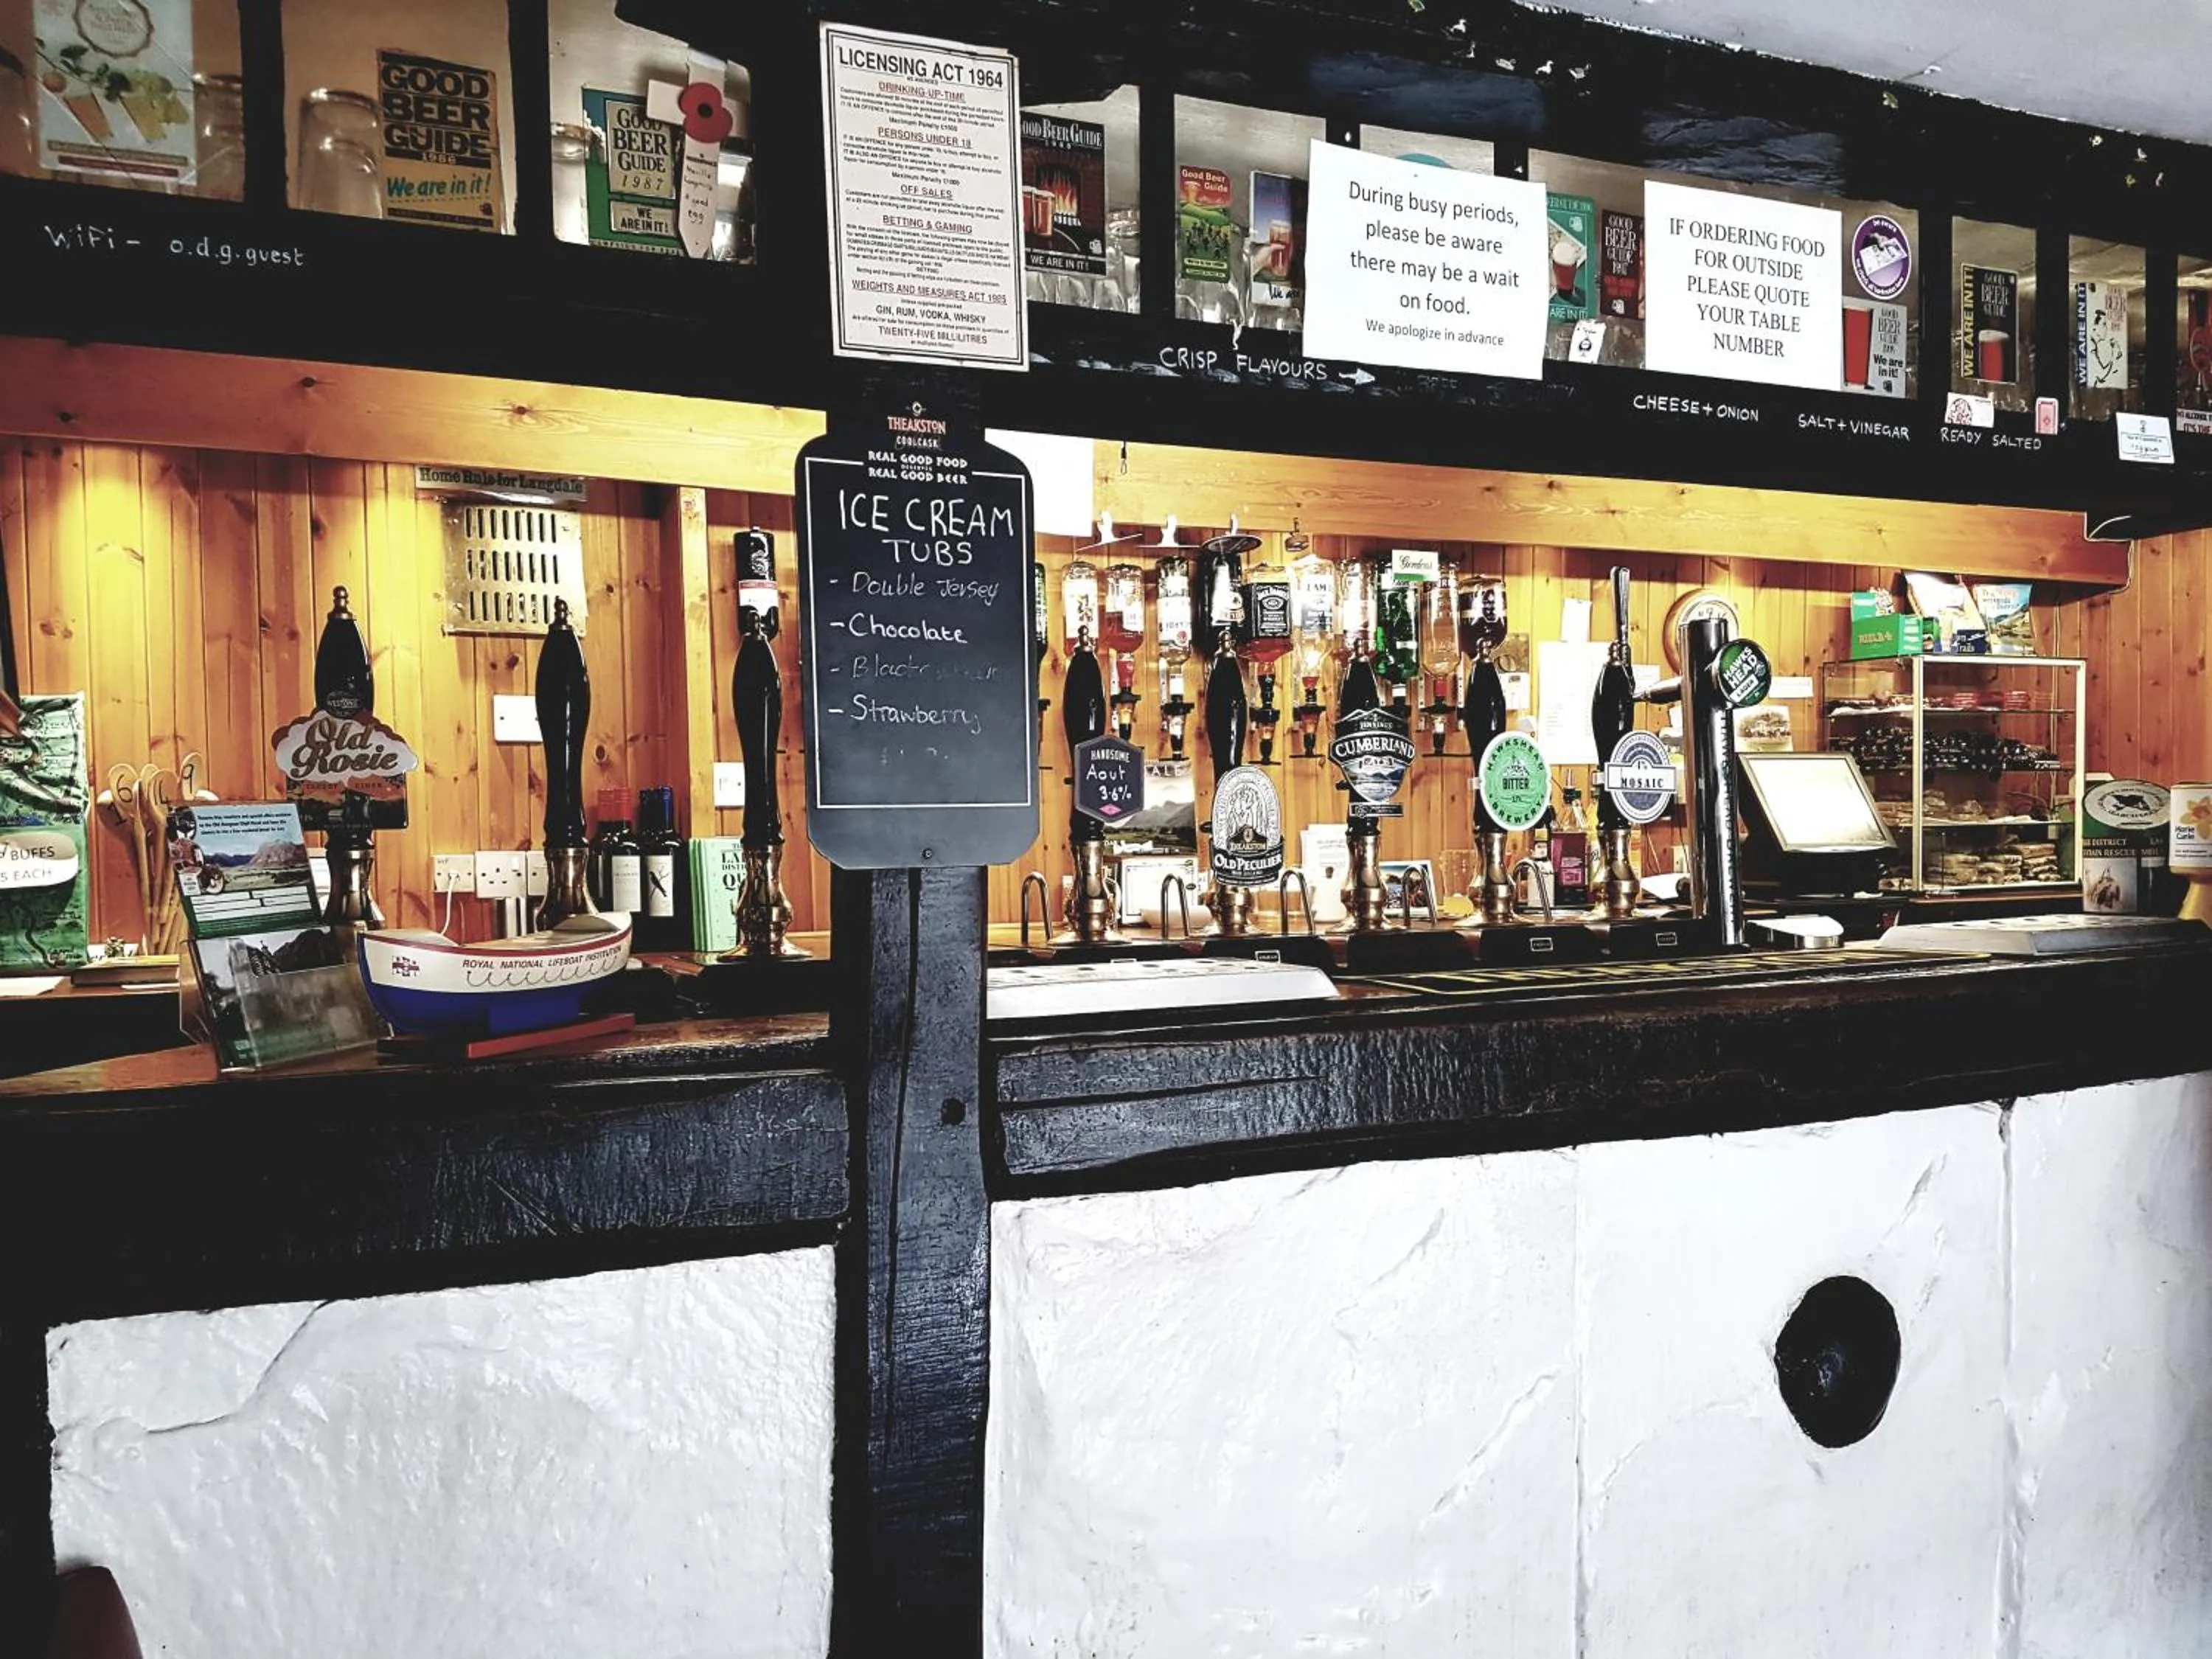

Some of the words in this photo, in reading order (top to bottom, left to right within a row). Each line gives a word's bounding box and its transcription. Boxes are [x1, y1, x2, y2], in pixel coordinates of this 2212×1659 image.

[838, 46, 927, 77] LICENSING
[932, 62, 963, 83] ACT
[968, 68, 1003, 88] 1964
[381, 63, 490, 99] GOOD
[383, 92, 490, 131] BEER
[383, 124, 491, 157] GUIDE
[613, 128, 669, 156] BEER
[878, 127, 922, 142] PERSONS
[926, 135, 959, 147] UNDER
[1022, 120, 1041, 137] OOD
[1043, 118, 1069, 143] BEER
[1070, 123, 1102, 147] GUIDE
[618, 151, 666, 173] GUIDE
[386, 177, 414, 197] We
[417, 181, 448, 195] are
[451, 174, 466, 195] in
[622, 175, 664, 191] 1987
[1182, 169, 1204, 180] Good
[1206, 172, 1226, 182] Beer
[1204, 182, 1228, 192] Guide
[900, 184, 918, 195] OFF
[922, 187, 953, 198] SALES
[1349, 181, 1404, 212] During
[1409, 192, 1447, 219] busy
[1453, 202, 1519, 227] periods,
[621, 218, 641, 230] ARE
[636, 206, 653, 219] WE
[883, 215, 924, 229] BETTING
[935, 221, 973, 234] GAMING
[1366, 219, 1419, 244] please
[1425, 227, 1446, 247] be
[1452, 234, 1503, 254] aware
[1604, 226, 1636, 251] BEER
[1669, 218, 1684, 235] IF
[1689, 220, 1778, 251] ORDERING
[1781, 235, 1825, 258] FOOD
[1030, 254, 1044, 265] WE
[1046, 257, 1064, 268] ARE
[1065, 259, 1074, 269] IN
[1350, 250, 1396, 274] there
[1402, 260, 1437, 282] may
[1443, 262, 1463, 282] be
[1469, 270, 1478, 283] a
[1484, 270, 1520, 288] wait
[1694, 248, 1728, 269] FOR
[1732, 254, 1804, 281] OUTSIDE
[852, 279, 894, 293] WEIGHTS
[897, 283, 915, 293] AND
[918, 285, 966, 300] MEASURES
[968, 291, 985, 301] ACT
[1687, 275, 1750, 300] PLEASE
[1754, 285, 1810, 307] QUOTE
[1964, 289, 1974, 308] IN
[875, 305, 894, 316] GIN,
[896, 307, 917, 319] RUM,
[920, 310, 951, 321] VODKA,
[953, 313, 986, 324] WHISKY
[1399, 294, 1421, 310] on
[1426, 293, 1470, 315] food.
[2078, 302, 2086, 318] IN
[1697, 304, 1745, 326] YOUR
[1750, 310, 1801, 333] TABLE
[1964, 311, 1974, 347] ARE
[1366, 318, 1385, 333] We
[1388, 322, 1441, 341] apologize
[1444, 328, 1455, 341] in
[1458, 330, 1504, 347] advance
[1713, 333, 1784, 358] NUMBER
[2078, 321, 2086, 355] ARE
[1160, 347, 1217, 370] CRISP
[1236, 353, 1328, 380] FLAVOURS
[1874, 353, 1887, 365] We
[1889, 358, 1903, 368] are
[1964, 349, 1974, 378] WE
[2078, 358, 2086, 383] WE
[1633, 394, 1700, 414] CHEESE
[1717, 404, 1759, 422] ONION
[888, 416, 946, 436] THEAKSTON
[1798, 413, 1837, 430] SALT
[1849, 422, 1910, 441] VINEGAR
[1940, 427, 1982, 445] READY
[1993, 435, 2042, 450] SALTED
[868, 451, 897, 462] REAL
[900, 453, 933, 465] GOOD
[936, 456, 967, 468] FOOD
[420, 467, 461, 483] Home
[496, 473, 517, 487] for
[518, 475, 583, 494] Langdale
[868, 467, 897, 479] REAL
[900, 470, 933, 481] GOOD
[937, 473, 968, 484] BEER
[839, 489, 889, 532] ICE
[905, 498, 1014, 537] CREAM
[882, 538, 973, 566] TUBS
[852, 571, 925, 597] Double
[936, 578, 999, 606] Jersey
[849, 613, 967, 644] Chocolate
[1723, 647, 1752, 681] HAWKS
[1728, 655, 1757, 689] HEAD
[850, 694, 981, 734] Strawberry
[306, 717, 373, 751] Old
[290, 741, 398, 779] Rosie
[1091, 749, 1130, 762] HANDSOME
[1335, 737, 1414, 758] CUMBERLAND
[1487, 739, 1544, 771] HAWKSHEAD
[116, 774, 133, 802] 6
[182, 764, 195, 794] 9
[1503, 778, 1529, 790] BITTER
[1621, 778, 1664, 788] MOSAIC
[1492, 801, 1542, 824] BREWERY
[11, 846, 55, 861] BUFFS
[1214, 853, 1236, 869] OLD
[1237, 854, 1281, 870] PECULIER
[14, 869, 52, 881] EACH
[462, 959, 495, 970] ROYAL
[500, 959, 543, 970] NATIONAL
[547, 955, 582, 968] LIFEBOAT
[585, 947, 623, 962] INSTITUTION
